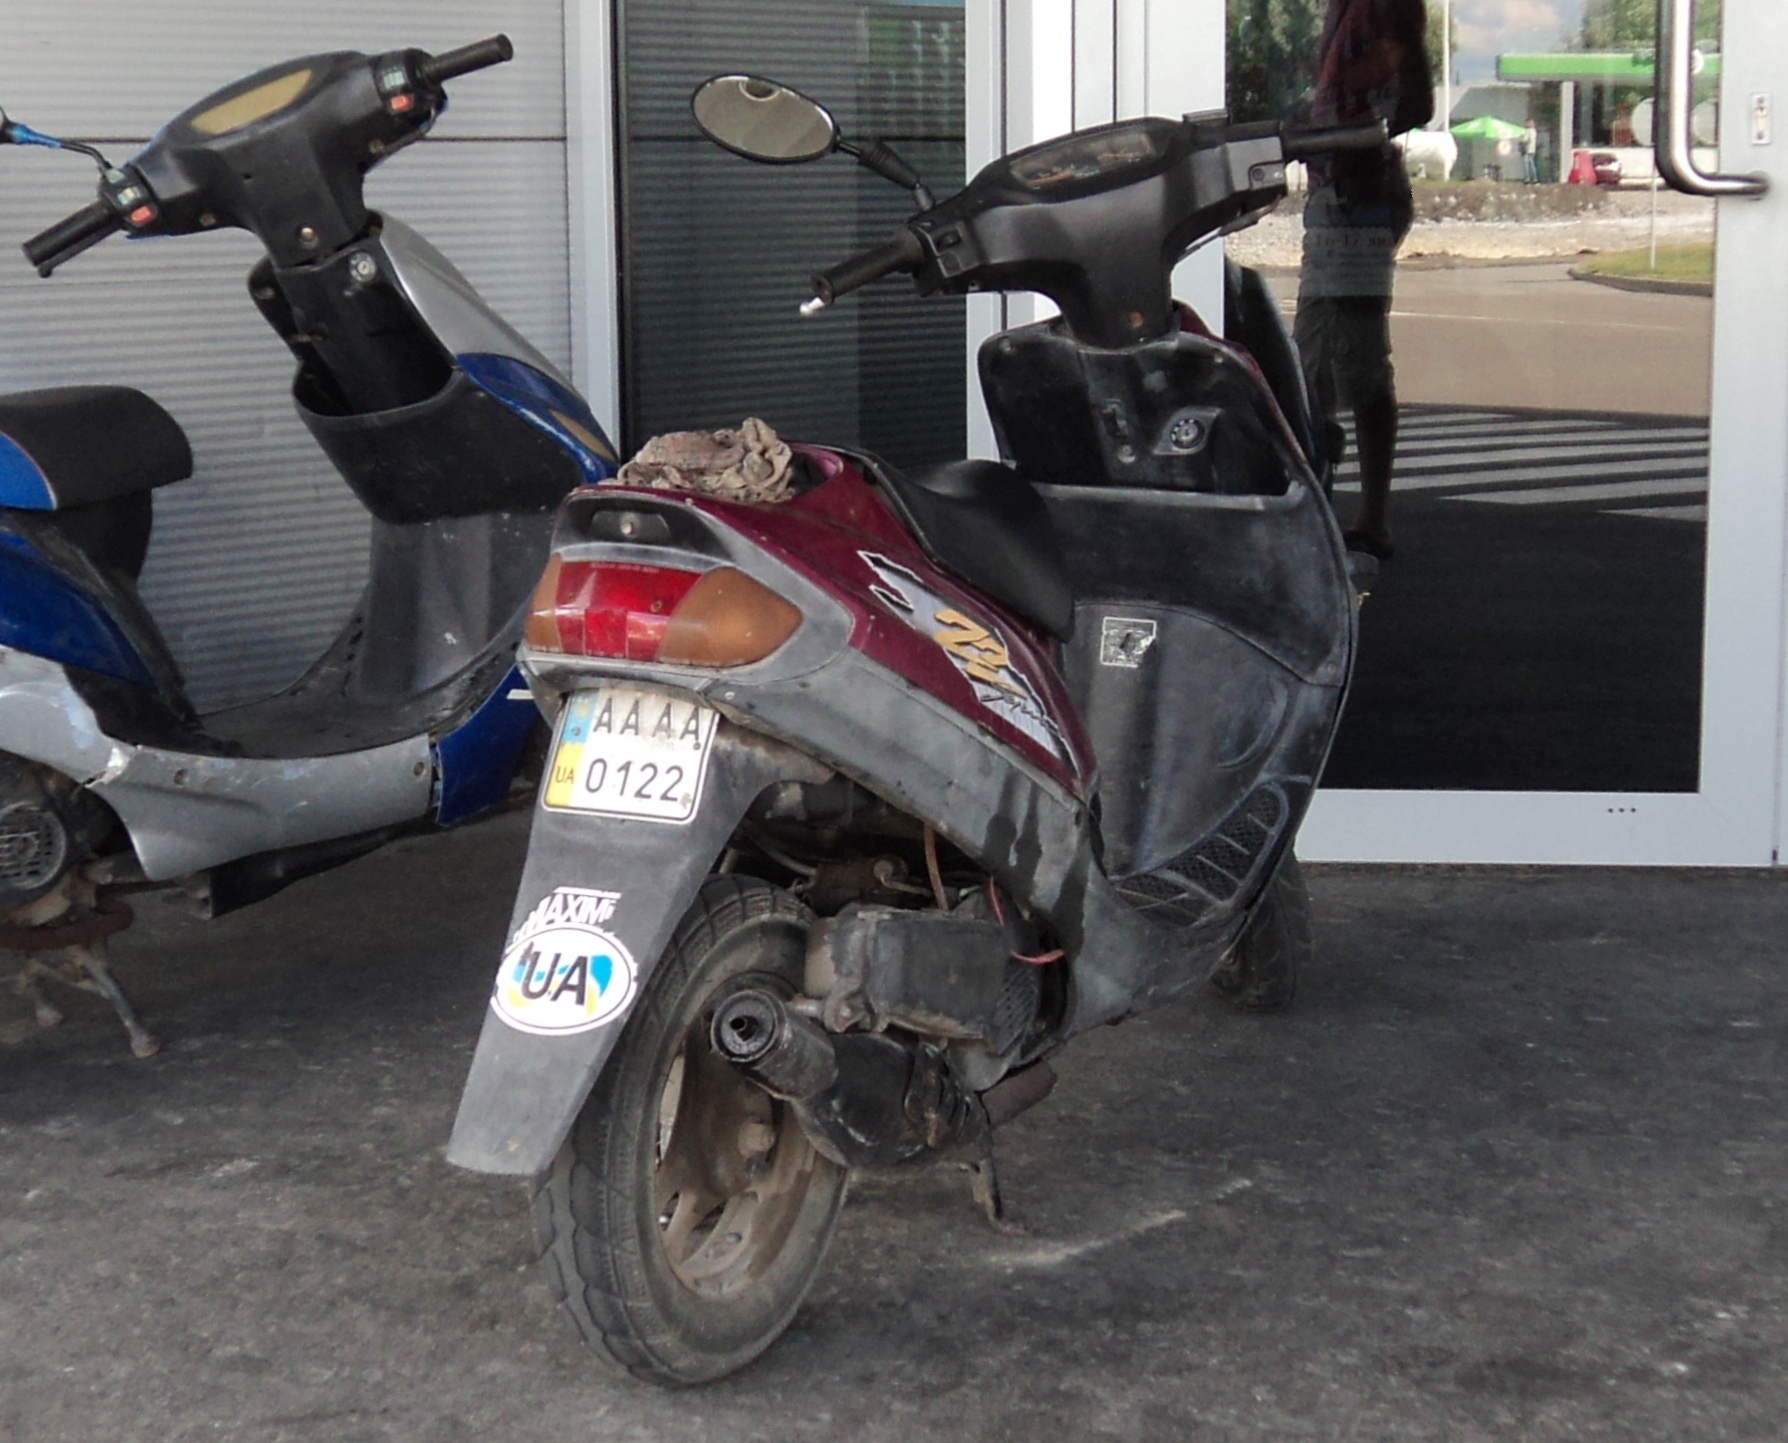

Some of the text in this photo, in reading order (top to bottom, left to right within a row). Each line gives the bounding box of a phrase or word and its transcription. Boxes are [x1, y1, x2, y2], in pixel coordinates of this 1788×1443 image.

[555, 766, 575, 784] UA
[585, 758, 684, 802] 0122
[521, 950, 589, 1006] UA
